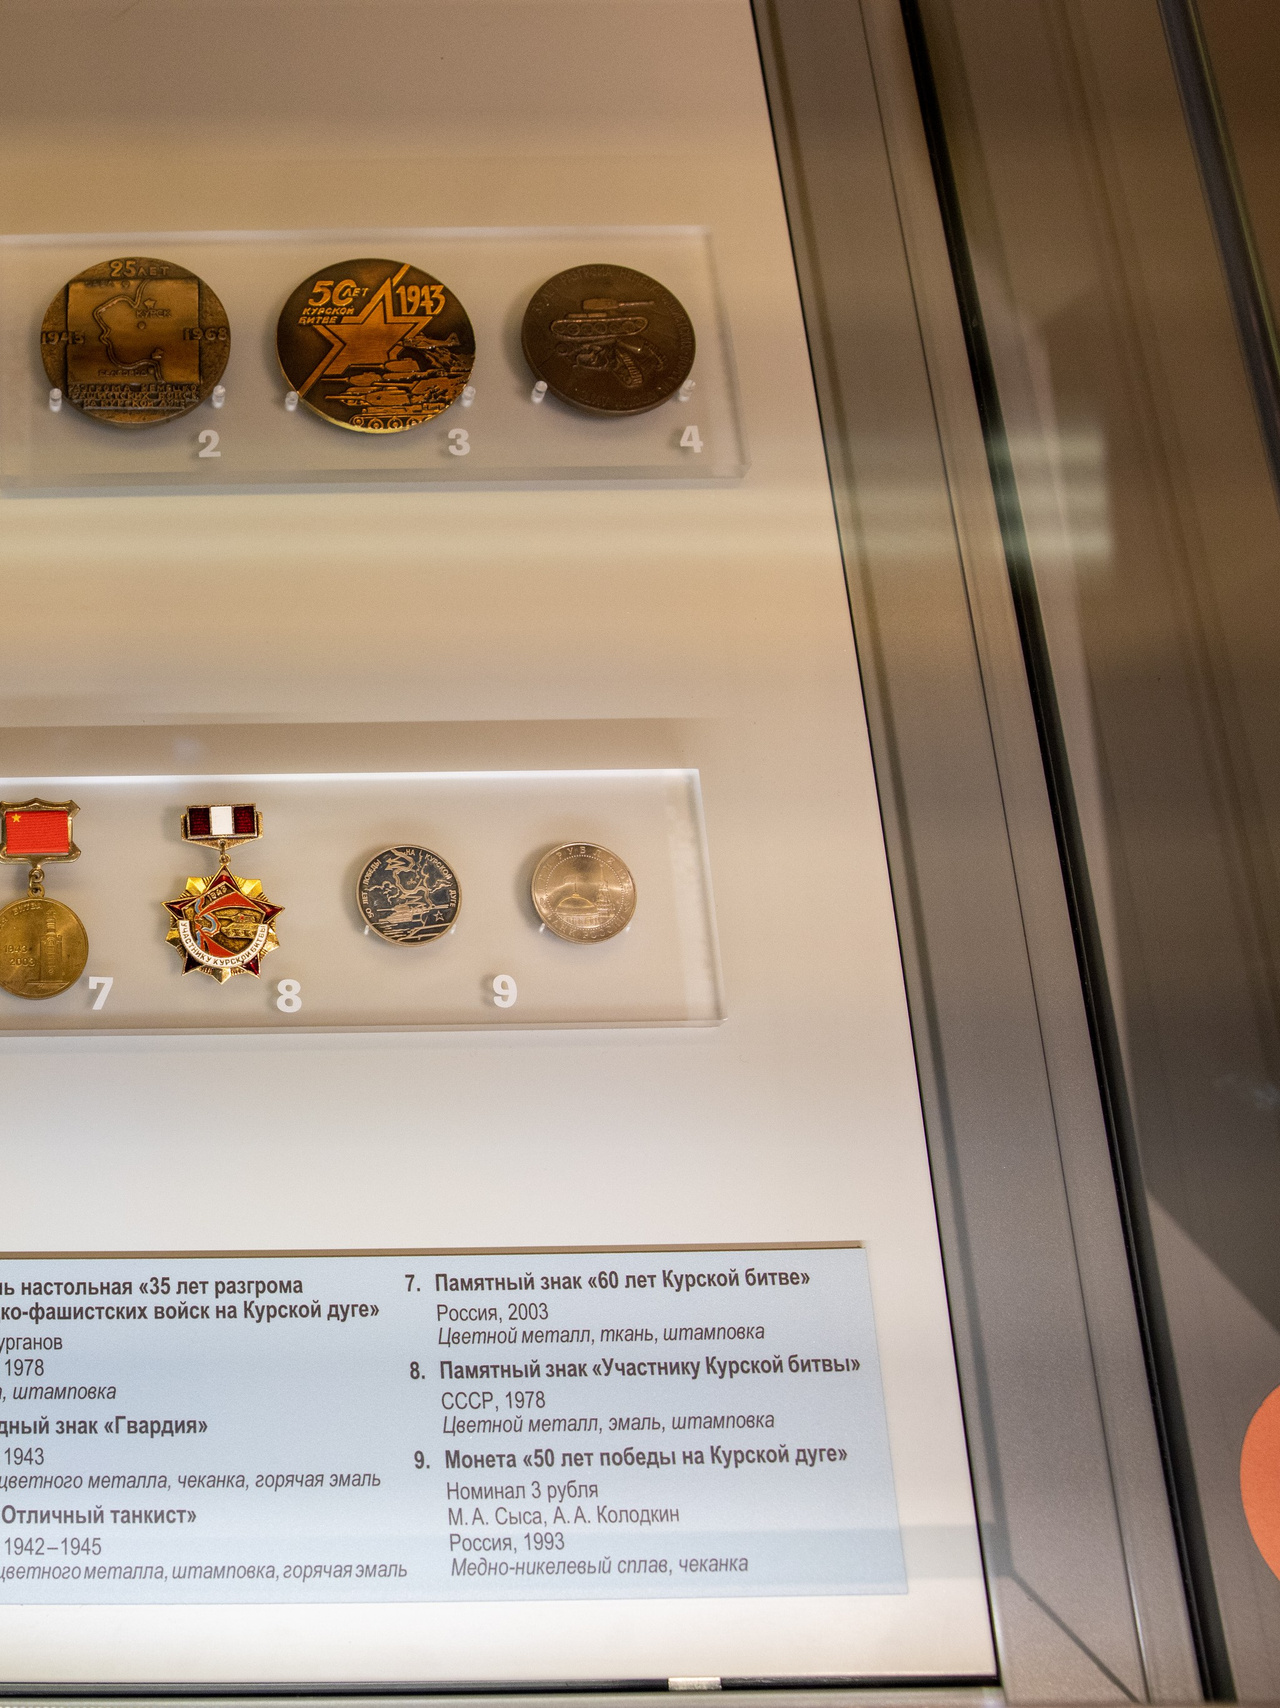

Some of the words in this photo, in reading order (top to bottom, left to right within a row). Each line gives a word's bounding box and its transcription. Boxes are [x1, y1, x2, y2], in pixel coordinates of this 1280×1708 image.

[109, 260, 137, 278] 25
[137, 266, 170, 277] ЛЕТ
[308, 279, 357, 307] 50
[342, 287, 369, 298] ЛЕТ
[396, 284, 446, 315] 1943
[298, 316, 337, 325] БИТВЕ
[183, 327, 228, 341] 1968
[198, 429, 221, 458] 2
[448, 428, 471, 456] 3
[680, 425, 703, 453] 4
[89, 976, 114, 1010] 7
[276, 979, 302, 1013] 8
[492, 974, 518, 1008] 9
[21, 1281, 133, 1296] настольная
[138, 1276, 171, 1295] «35
[175, 1280, 210, 1295] лет
[214, 1279, 304, 1299] разгрома
[404, 1273, 421, 1293] 7.
[435, 1271, 535, 1292] Памятный
[540, 1275, 583, 1291] знак
[587, 1270, 619, 1290] «60
[624, 1274, 657, 1289] лет
[661, 1268, 740, 1293] Курской
[744, 1267, 811, 1287] битве»
[154, 1301, 210, 1320] войск
[215, 1304, 238, 1320] на
[243, 1300, 322, 1324] Курской
[326, 1303, 380, 1323] дуге»
[436, 1303, 503, 1324] Россия,
[507, 1302, 549, 1321] 2003
[438, 1326, 518, 1348] Цветной
[521, 1329, 595, 1346] металл,
[600, 1328, 658, 1345] ткань,
[663, 1325, 765, 1342] штамповка
[409, 1360, 426, 1380] 8.
[439, 1360, 541, 1380] Памятный
[545, 1362, 589, 1378] знак
[592, 1357, 701, 1380] «Участнику
[705, 1355, 784, 1380] Курской
[787, 1353, 861, 1374] битвы»
[55, 1420, 99, 1435] знак
[103, 1415, 208, 1439] «Гвардия»
[442, 1414, 524, 1437] Цветной
[528, 1417, 603, 1435] металл,
[608, 1416, 666, 1433] эмаль,
[671, 1414, 775, 1430] штамповка
[413, 1450, 431, 1470] 9.
[444, 1449, 517, 1469] Монета
[522, 1448, 555, 1468] «50
[560, 1452, 594, 1467] лет
[599, 1446, 677, 1469] победы
[682, 1450, 705, 1465] на
[709, 1444, 790, 1470] Курской
[794, 1447, 848, 1468] дуге»
[87, 1474, 171, 1492] металла,
[177, 1474, 249, 1491] чеканка,
[255, 1473, 325, 1493] горячая
[329, 1473, 381, 1488] эмаль
[446, 1481, 526, 1500] Номинал
[531, 1480, 542, 1499] 3
[547, 1479, 599, 1504] рубля
[109, 1509, 197, 1524] танкист»
[494, 1506, 547, 1528] Сыса,
[596, 1504, 680, 1526] Колодкин
[83, 1565, 168, 1583] металла,
[171, 1564, 280, 1582] штамповка,
[282, 1564, 353, 1583] горячая
[355, 1563, 408, 1578] эмаль
[451, 1557, 612, 1577] Медно-никелевый
[617, 1558, 673, 1576] сплав,
[678, 1557, 749, 1573] чеканка
